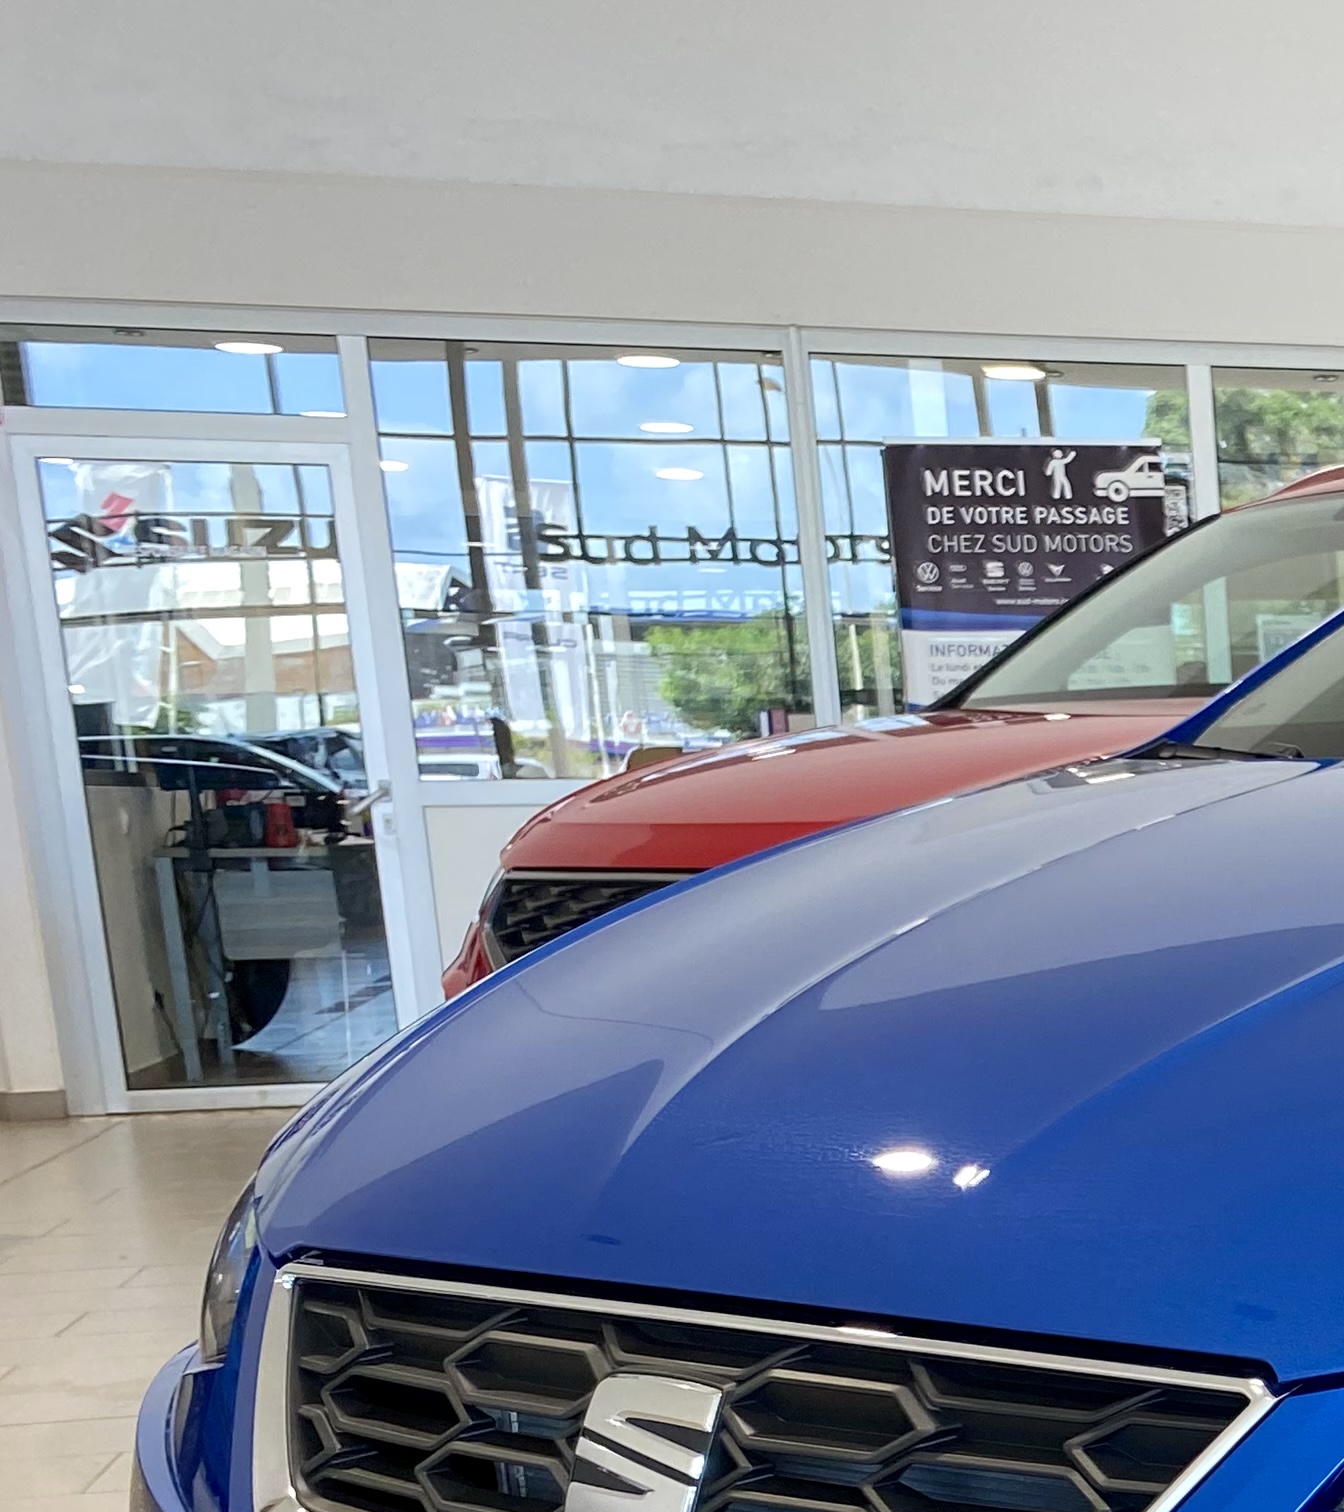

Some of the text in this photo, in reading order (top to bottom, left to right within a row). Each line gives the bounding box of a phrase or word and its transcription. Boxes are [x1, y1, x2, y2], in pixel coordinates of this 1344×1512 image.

[923, 468, 1026, 497] MERCI
[927, 506, 1130, 525] DE VOTRE PASSAGE
[927, 534, 1133, 554] CHEZ SUD MOTORS
